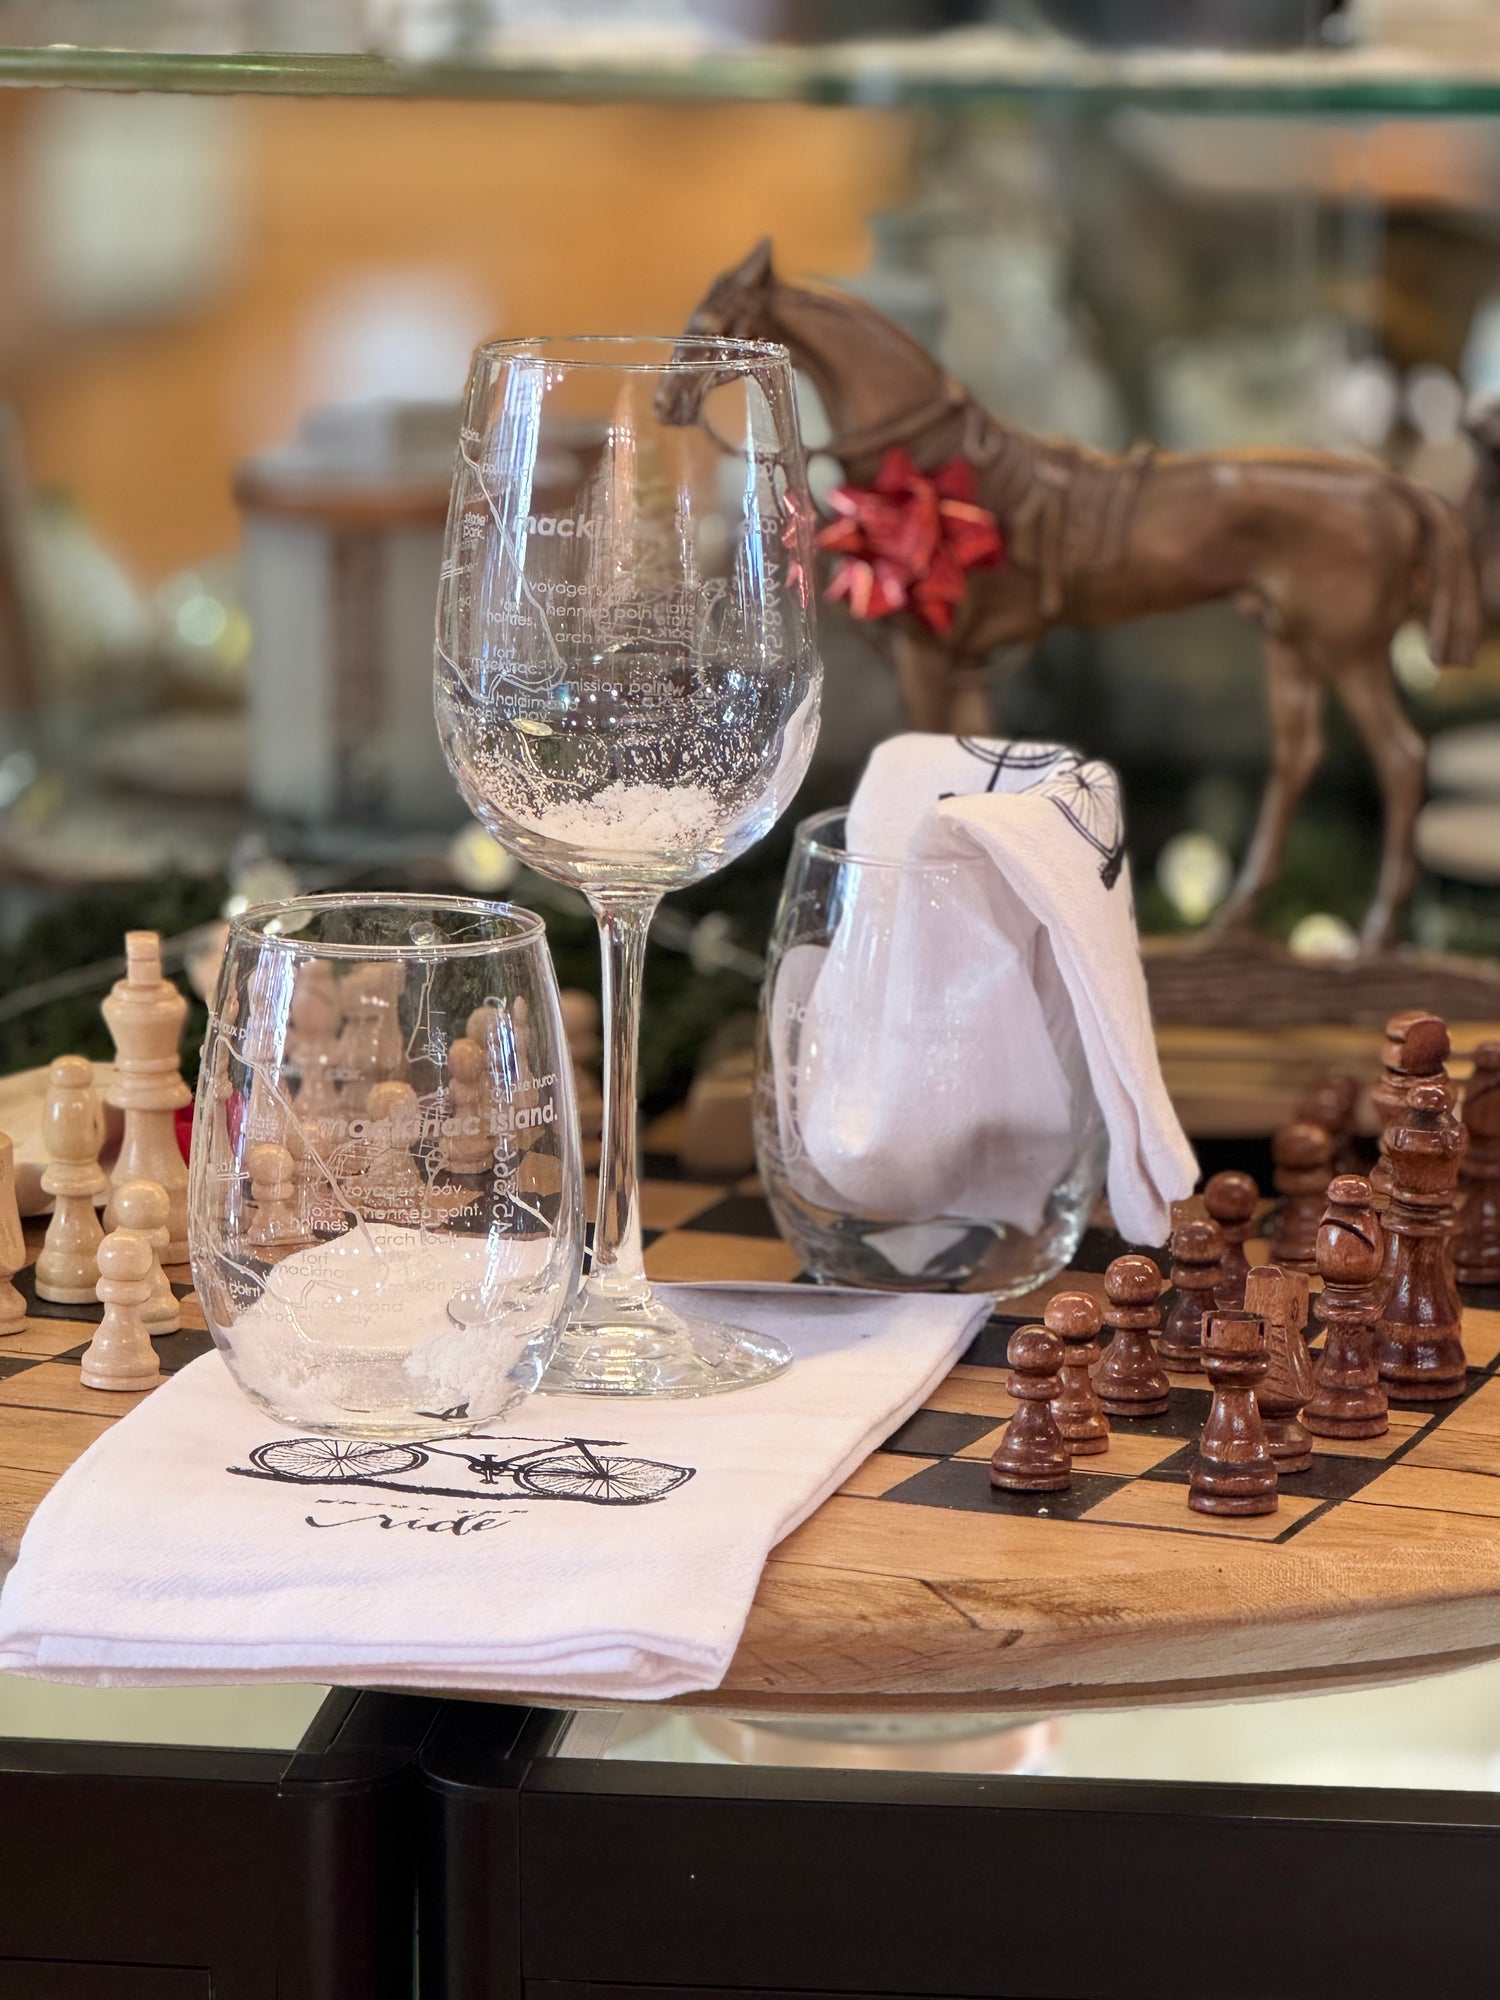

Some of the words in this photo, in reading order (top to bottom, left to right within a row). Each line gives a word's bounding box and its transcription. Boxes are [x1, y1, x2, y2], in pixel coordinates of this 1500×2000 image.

[512, 514, 606, 538] macki
[554, 631, 593, 644] arch
[567, 677, 623, 693] mission
[509, 1078, 532, 1094] ake
[437, 1202, 483, 1222] point.
[374, 1232, 416, 1247] arch
[305, 1509, 511, 1536] ride
